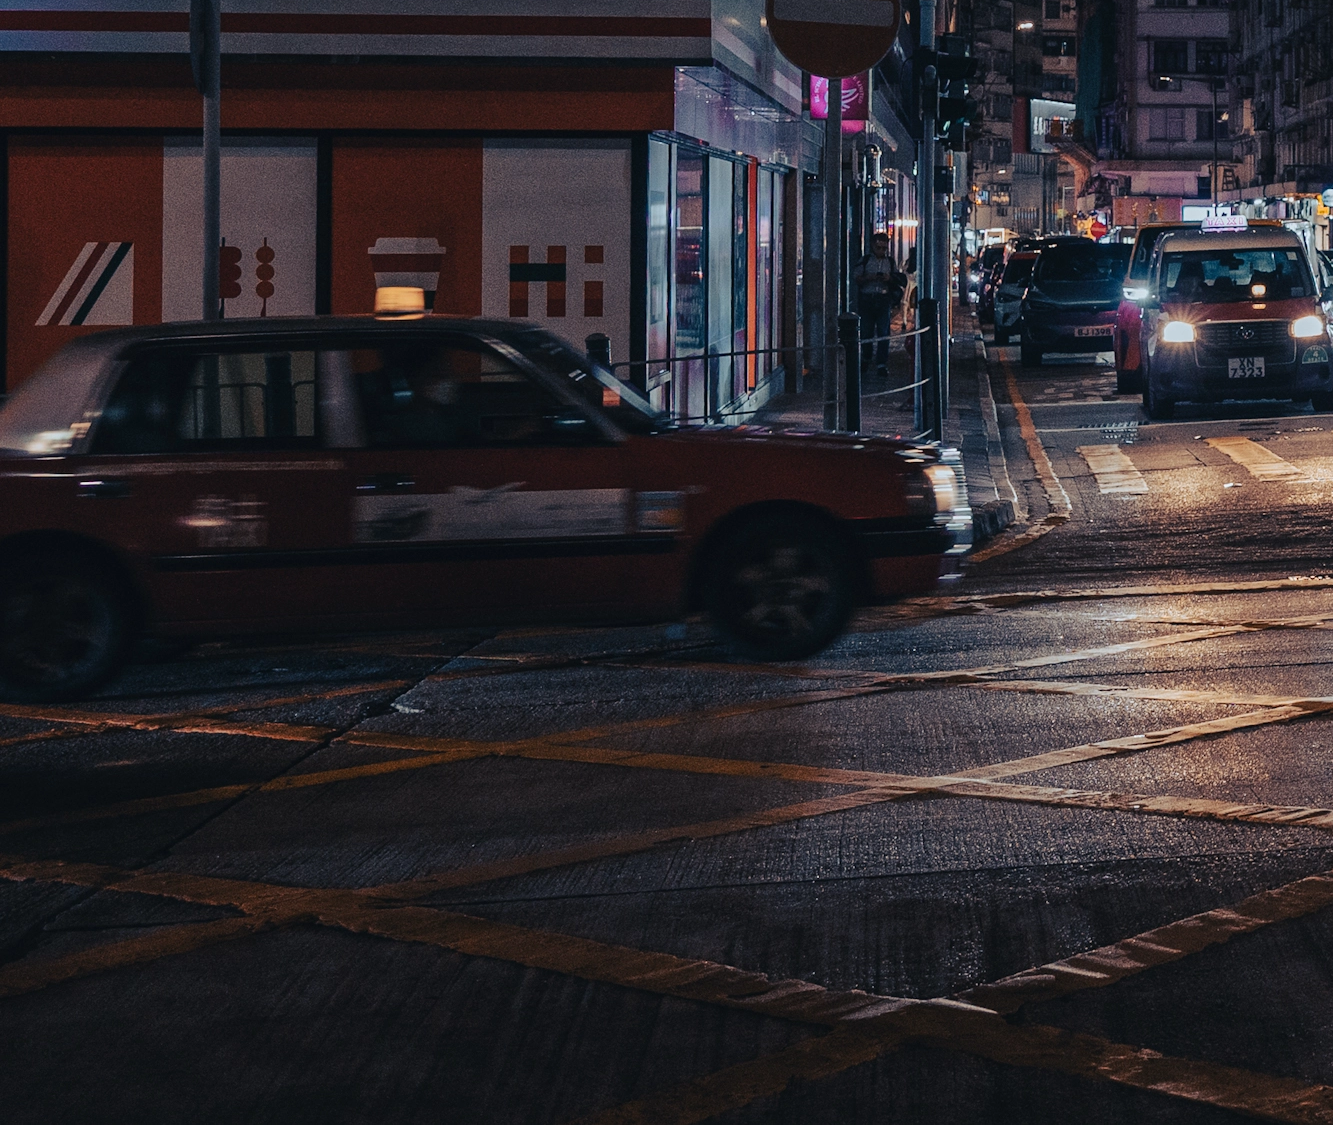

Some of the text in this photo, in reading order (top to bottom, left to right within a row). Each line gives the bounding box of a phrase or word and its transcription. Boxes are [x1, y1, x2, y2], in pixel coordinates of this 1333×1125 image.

[1206, 217, 1244, 226] TAXI
[509, 245, 604, 318] Hi
[1077, 327, 1112, 336] BJ 1398
[1238, 358, 1255, 367] XN
[1231, 367, 1264, 378] 7323
